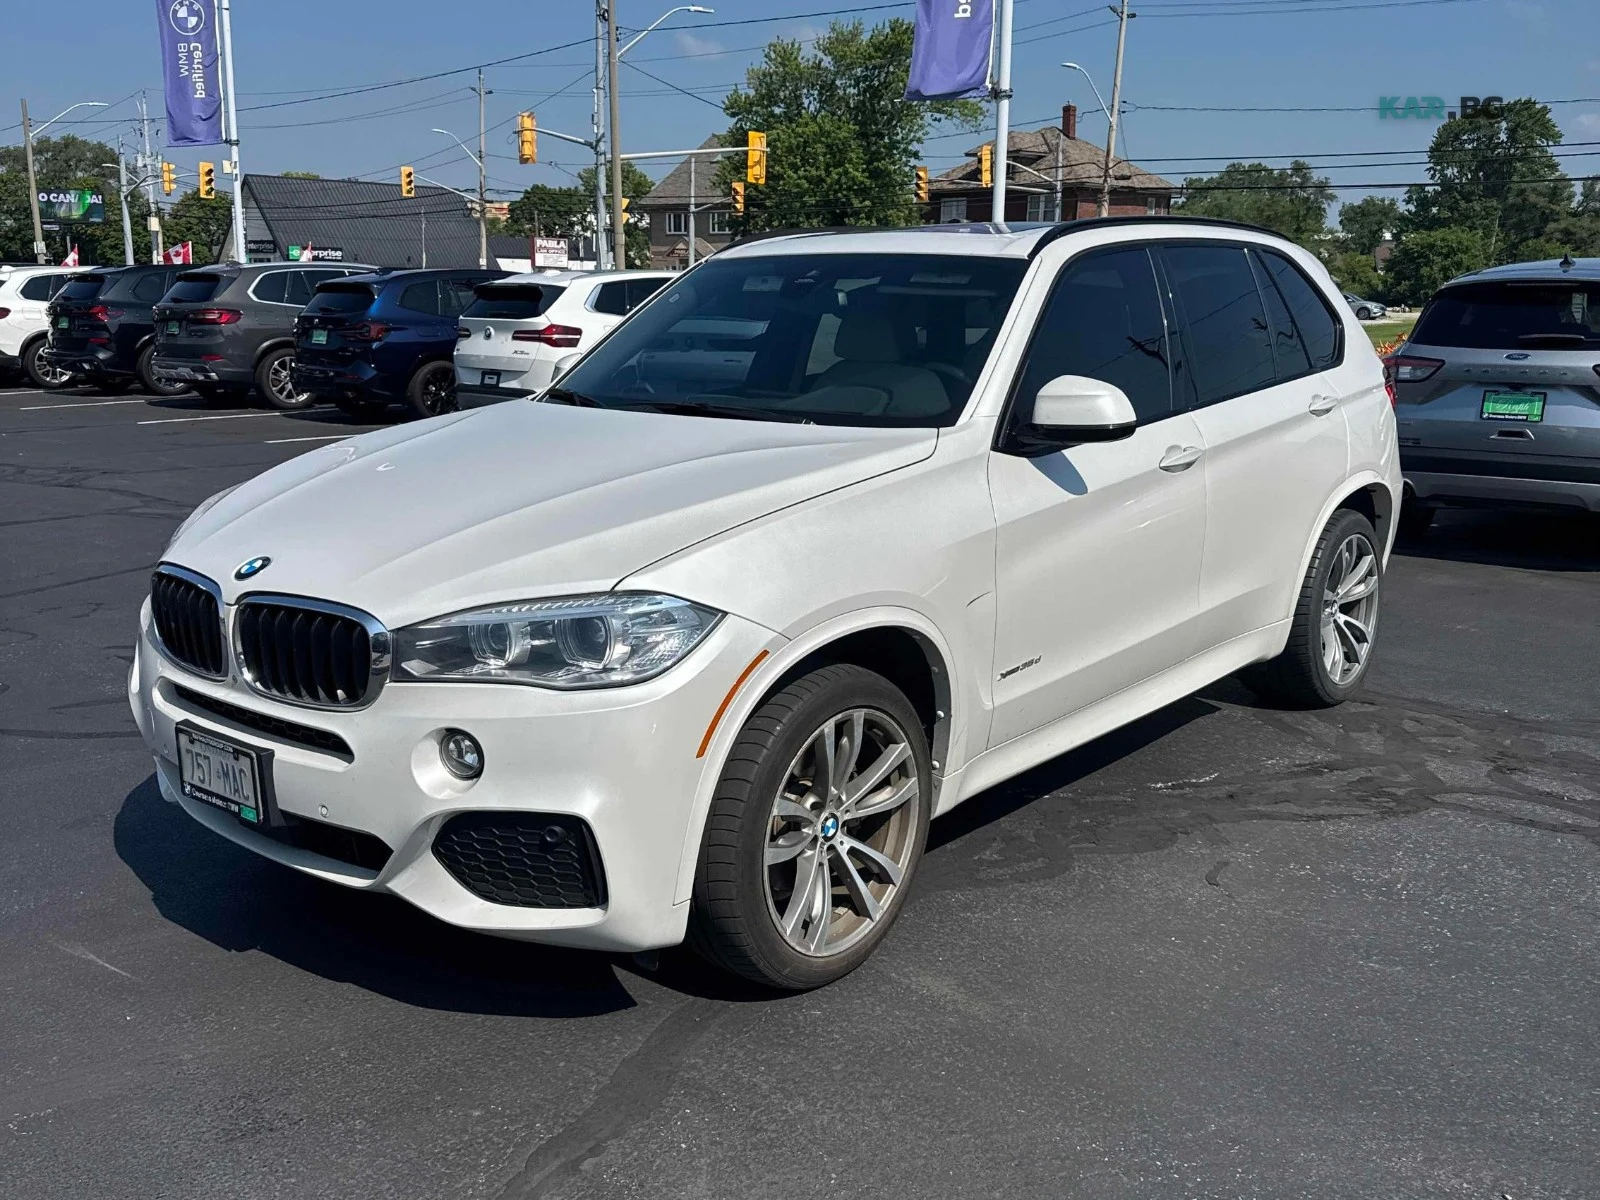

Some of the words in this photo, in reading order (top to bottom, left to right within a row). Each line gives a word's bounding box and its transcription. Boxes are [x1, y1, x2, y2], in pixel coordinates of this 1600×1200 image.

[38, 192, 48, 202] O
[537, 239, 567, 249] PABLA
[186, 747, 212, 787] 757
[220, 760, 250, 801] MAC
